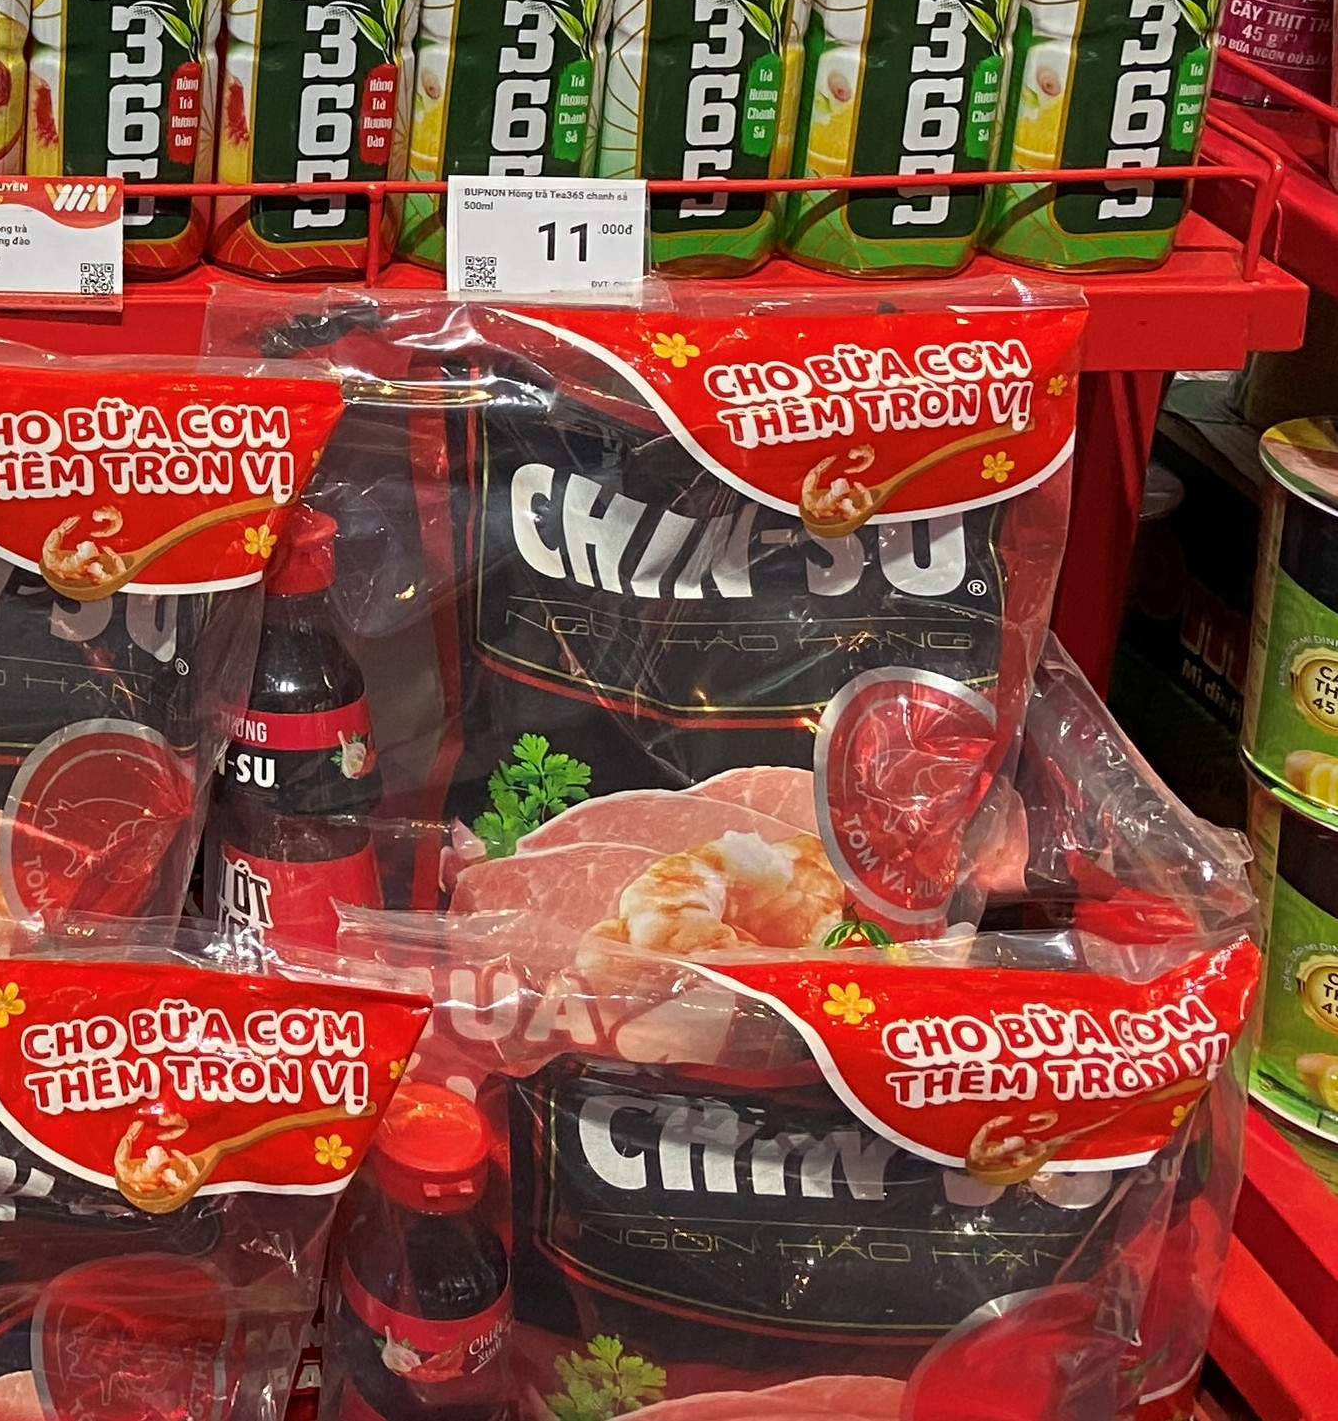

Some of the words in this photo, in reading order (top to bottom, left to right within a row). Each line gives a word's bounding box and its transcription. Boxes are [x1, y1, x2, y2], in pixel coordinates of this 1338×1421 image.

[15, 224, 27, 233] trà
[538, 221, 587, 261] 11
[706, 362, 802, 401] CHO
[810, 349, 906, 393] BỮA
[911, 342, 1028, 382] CƠM
[65, 399, 173, 448] BỮA
[178, 409, 290, 448] CƠM
[720, 401, 851, 446] THÊM
[864, 388, 975, 430] TRÒN
[978, 383, 1032, 428] VỊ
[97, 453, 235, 495] TRÒN
[243, 453, 294, 503] VỊ
